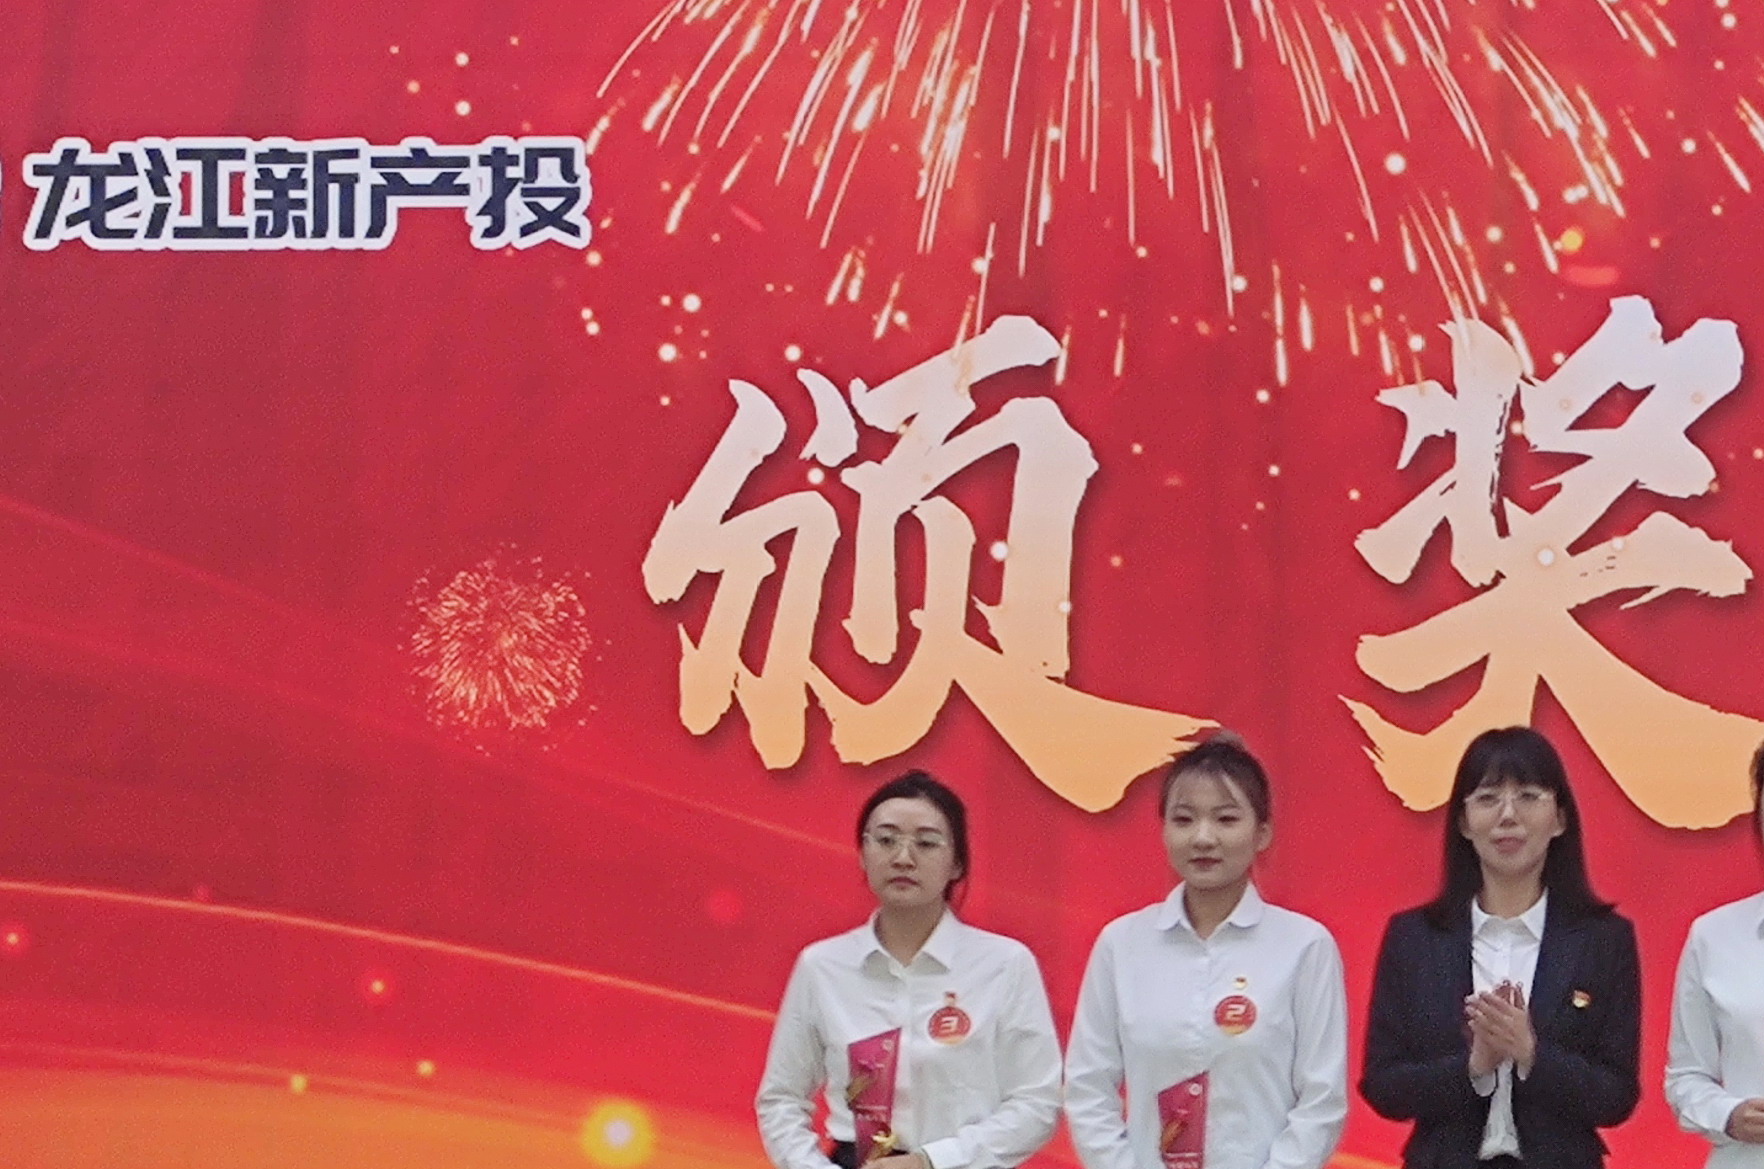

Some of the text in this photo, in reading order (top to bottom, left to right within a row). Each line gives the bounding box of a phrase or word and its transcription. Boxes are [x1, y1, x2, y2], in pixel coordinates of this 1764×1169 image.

[30, 146, 585, 241] 龙江新产投
[1225, 1004, 1246, 1020] 2
